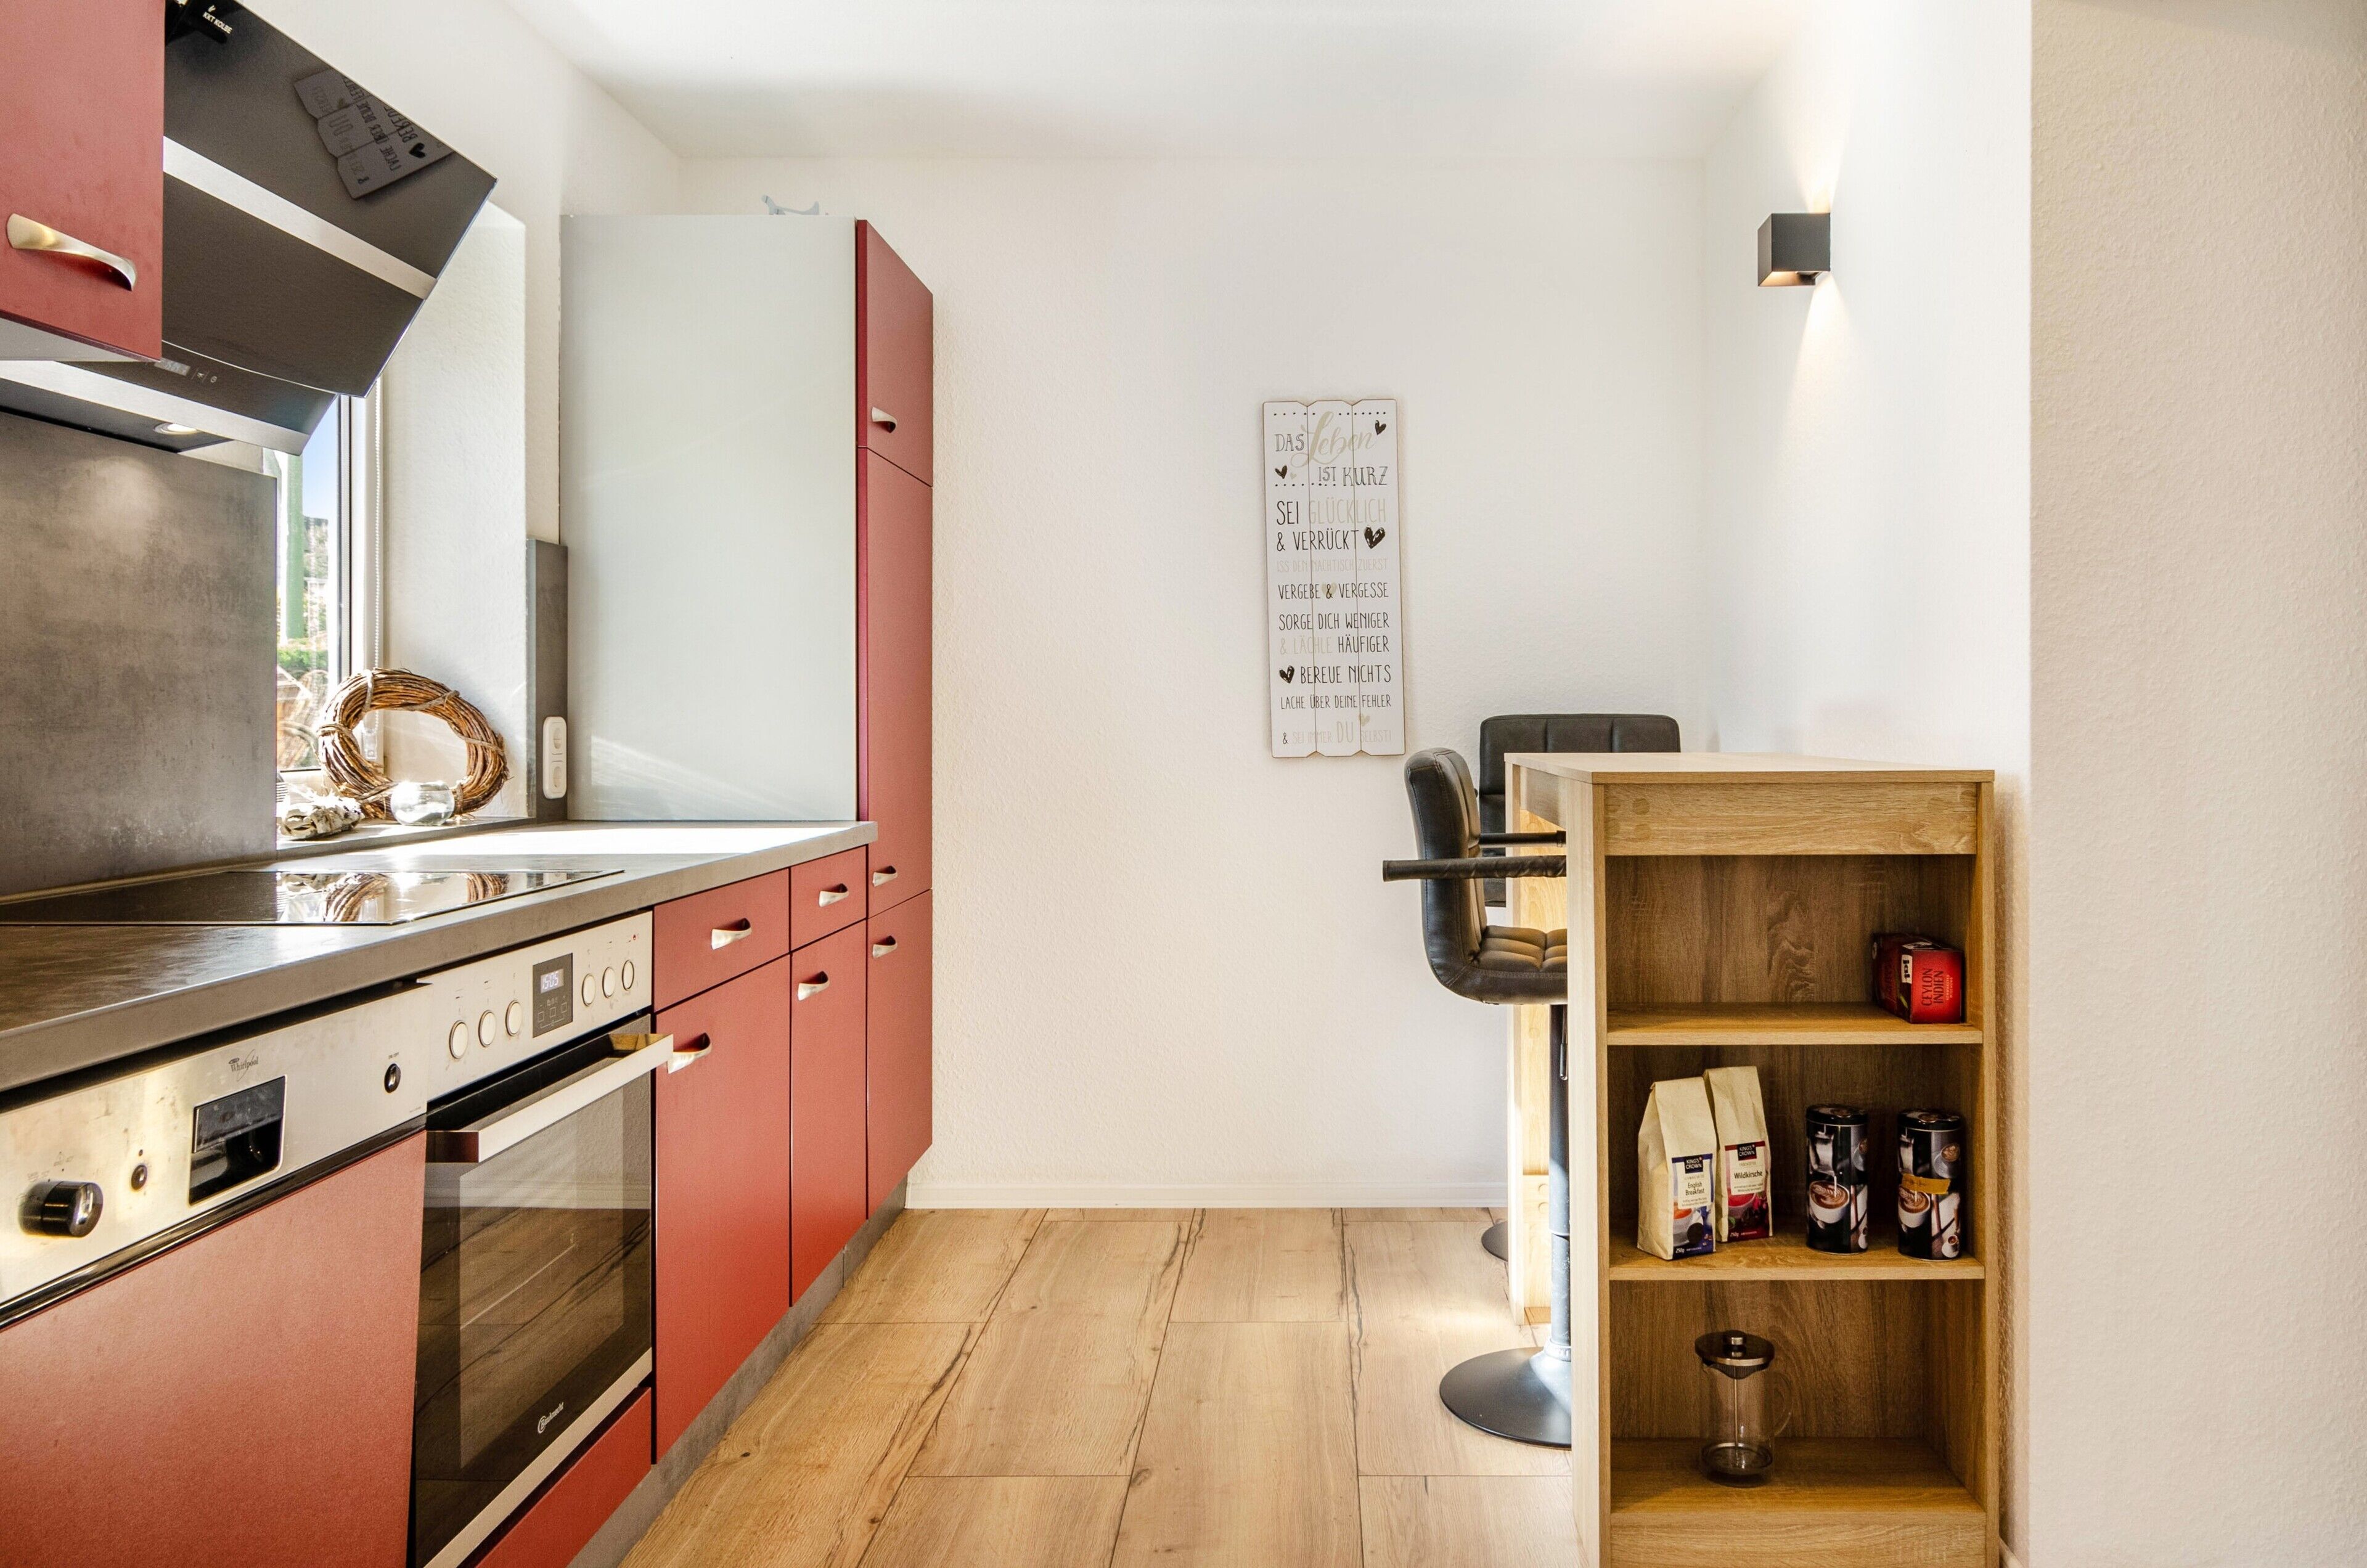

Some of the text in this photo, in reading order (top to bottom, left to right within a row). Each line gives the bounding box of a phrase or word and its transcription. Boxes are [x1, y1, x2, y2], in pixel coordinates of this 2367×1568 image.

[1274, 411, 1375, 468] DAS Leben
[1318, 466, 1388, 486] IST KURZ
[1277, 497, 1386, 525] SEI GLÜCKLICH
[1277, 528, 1359, 551] & VERRÜCKT
[1278, 582, 1389, 600] VERGEBE & VERGESSE
[1279, 612, 1389, 631] SORGE DICH WENIGER
[1280, 634, 1389, 654] & LÄCHLE HÄUFIGER
[1301, 664, 1391, 684] BEREUE NICHTS
[1281, 694, 1391, 709] LACHE ÜBER DEINE FEHLER
[1282, 732, 1288, 745] &
[1336, 721, 1354, 743] DU
[1921, 968, 1933, 1007] CEYLON
[1933, 971, 1944, 1005] INDIEN
[1734, 1170, 1763, 1179] Wildkirsche
